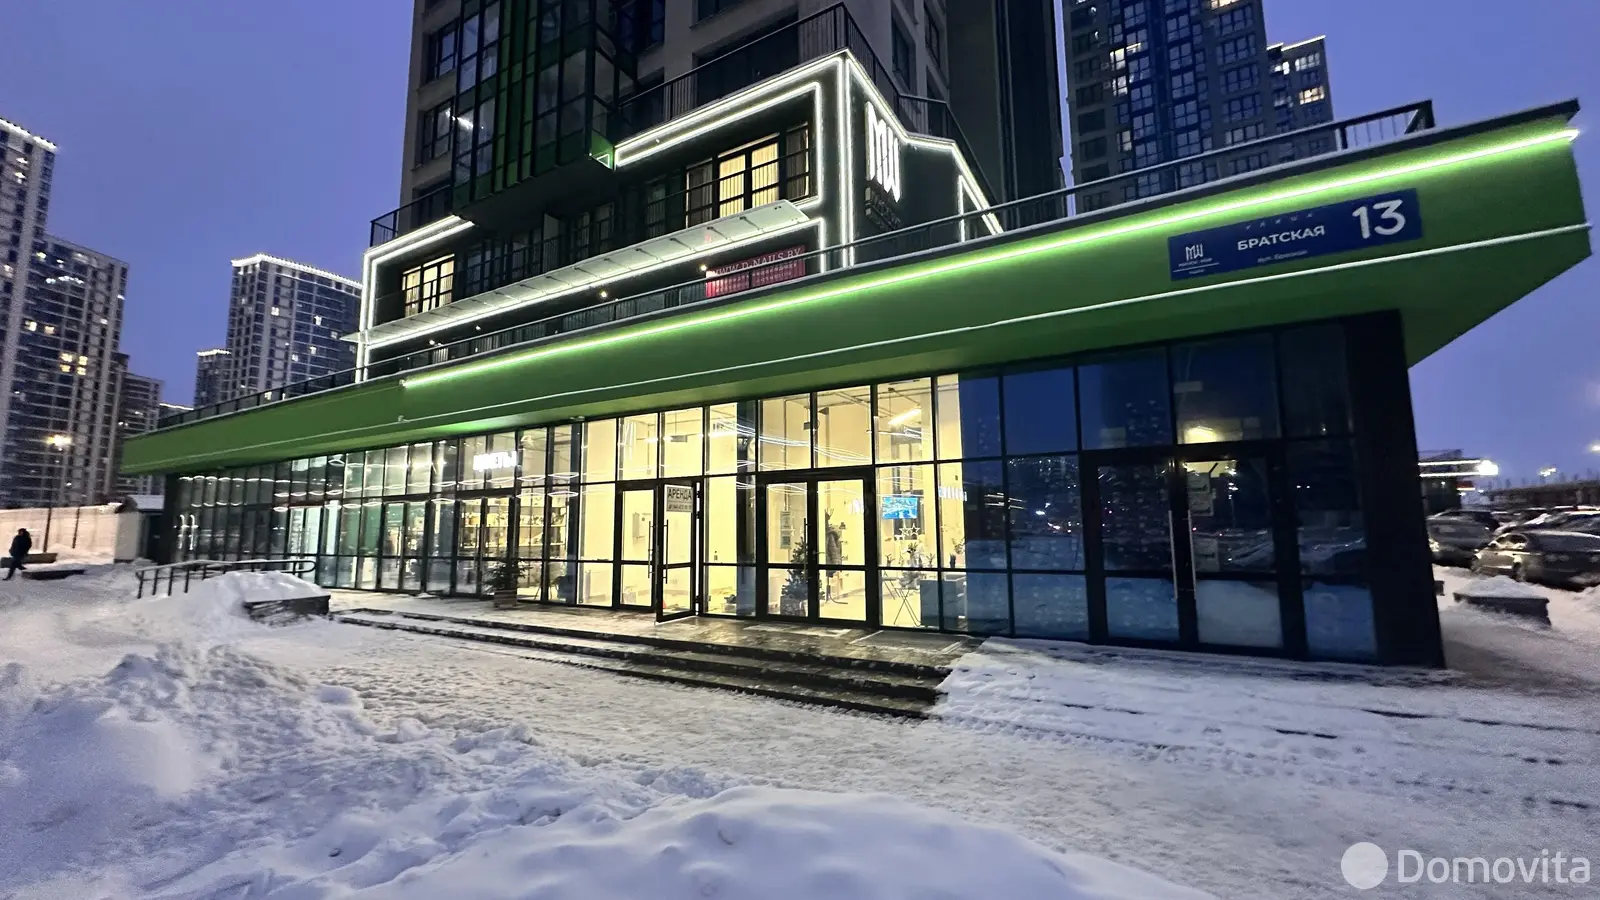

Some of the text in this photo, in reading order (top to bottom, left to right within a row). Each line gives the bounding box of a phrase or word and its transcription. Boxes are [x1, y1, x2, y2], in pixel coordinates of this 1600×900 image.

[1352, 199, 1406, 239] 13
[1237, 225, 1325, 251] БРАТСКАЯ
[667, 488, 693, 501] АРЕНДА
